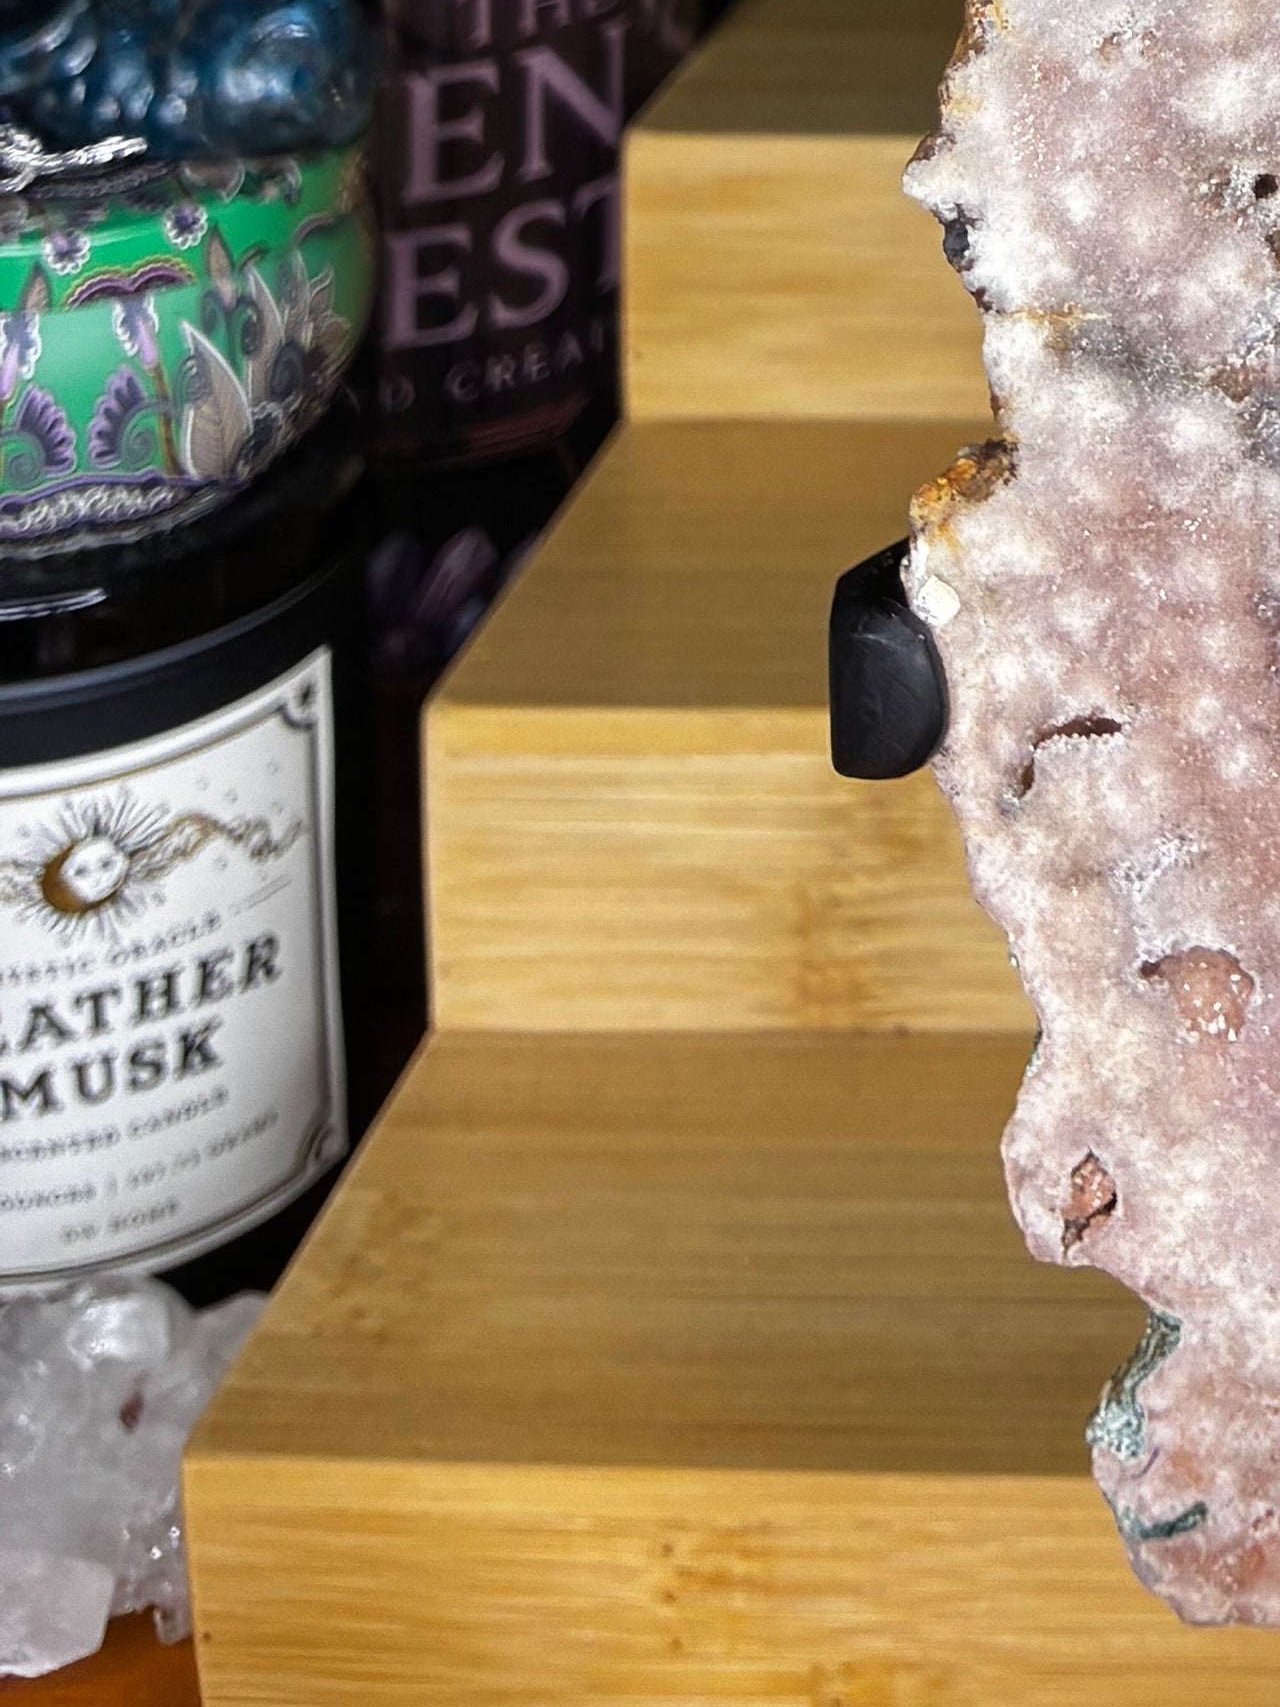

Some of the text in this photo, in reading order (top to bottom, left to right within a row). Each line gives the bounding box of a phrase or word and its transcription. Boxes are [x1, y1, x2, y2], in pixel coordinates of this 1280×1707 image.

[403, 21, 627, 207] EN
[384, 175, 625, 353] EST
[0, 930, 283, 1057] ATHER
[0, 1014, 224, 1123] MUSK
